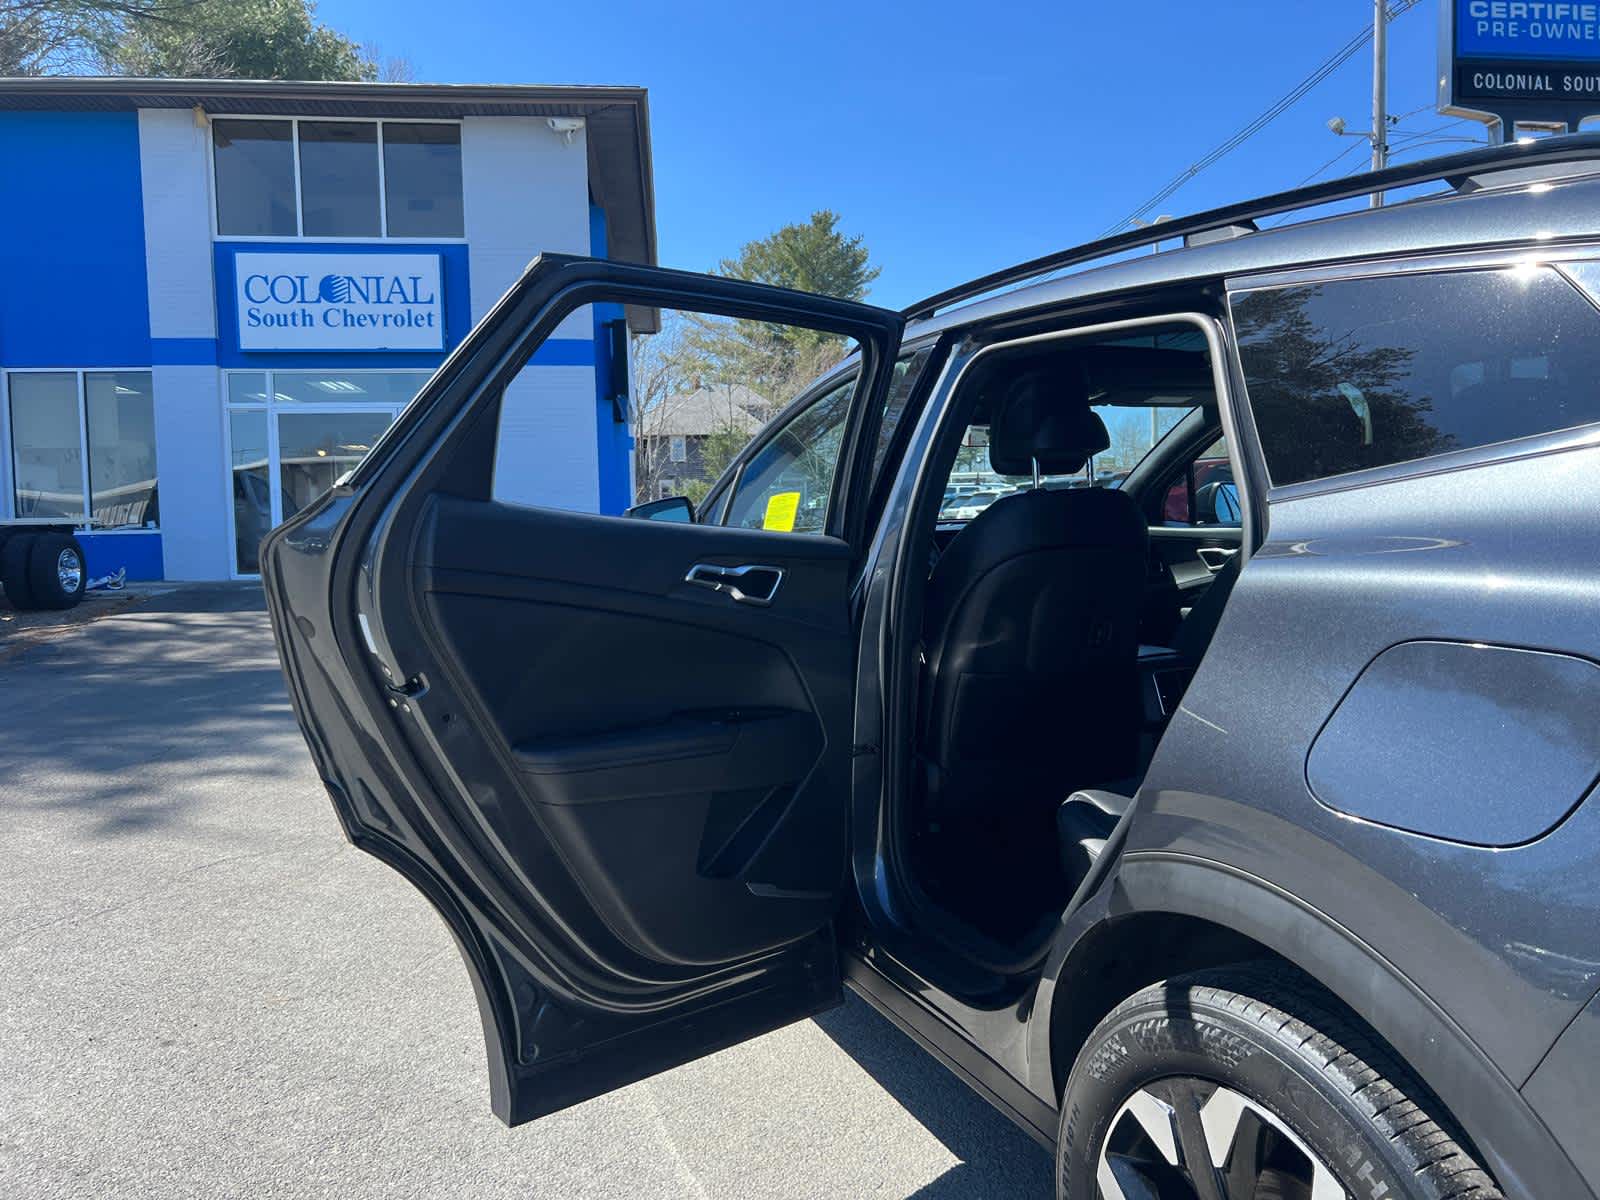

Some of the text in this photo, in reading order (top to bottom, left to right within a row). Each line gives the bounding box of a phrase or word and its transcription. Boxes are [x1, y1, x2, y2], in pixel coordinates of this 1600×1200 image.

[1470, 1, 1600, 21] CERTIFIE
[1477, 21, 1600, 40] PRE-OWNE
[1473, 72, 1553, 91] COLONIAL
[244, 274, 434, 305] COLONIAL
[247, 307, 435, 328] South Chevrolet
